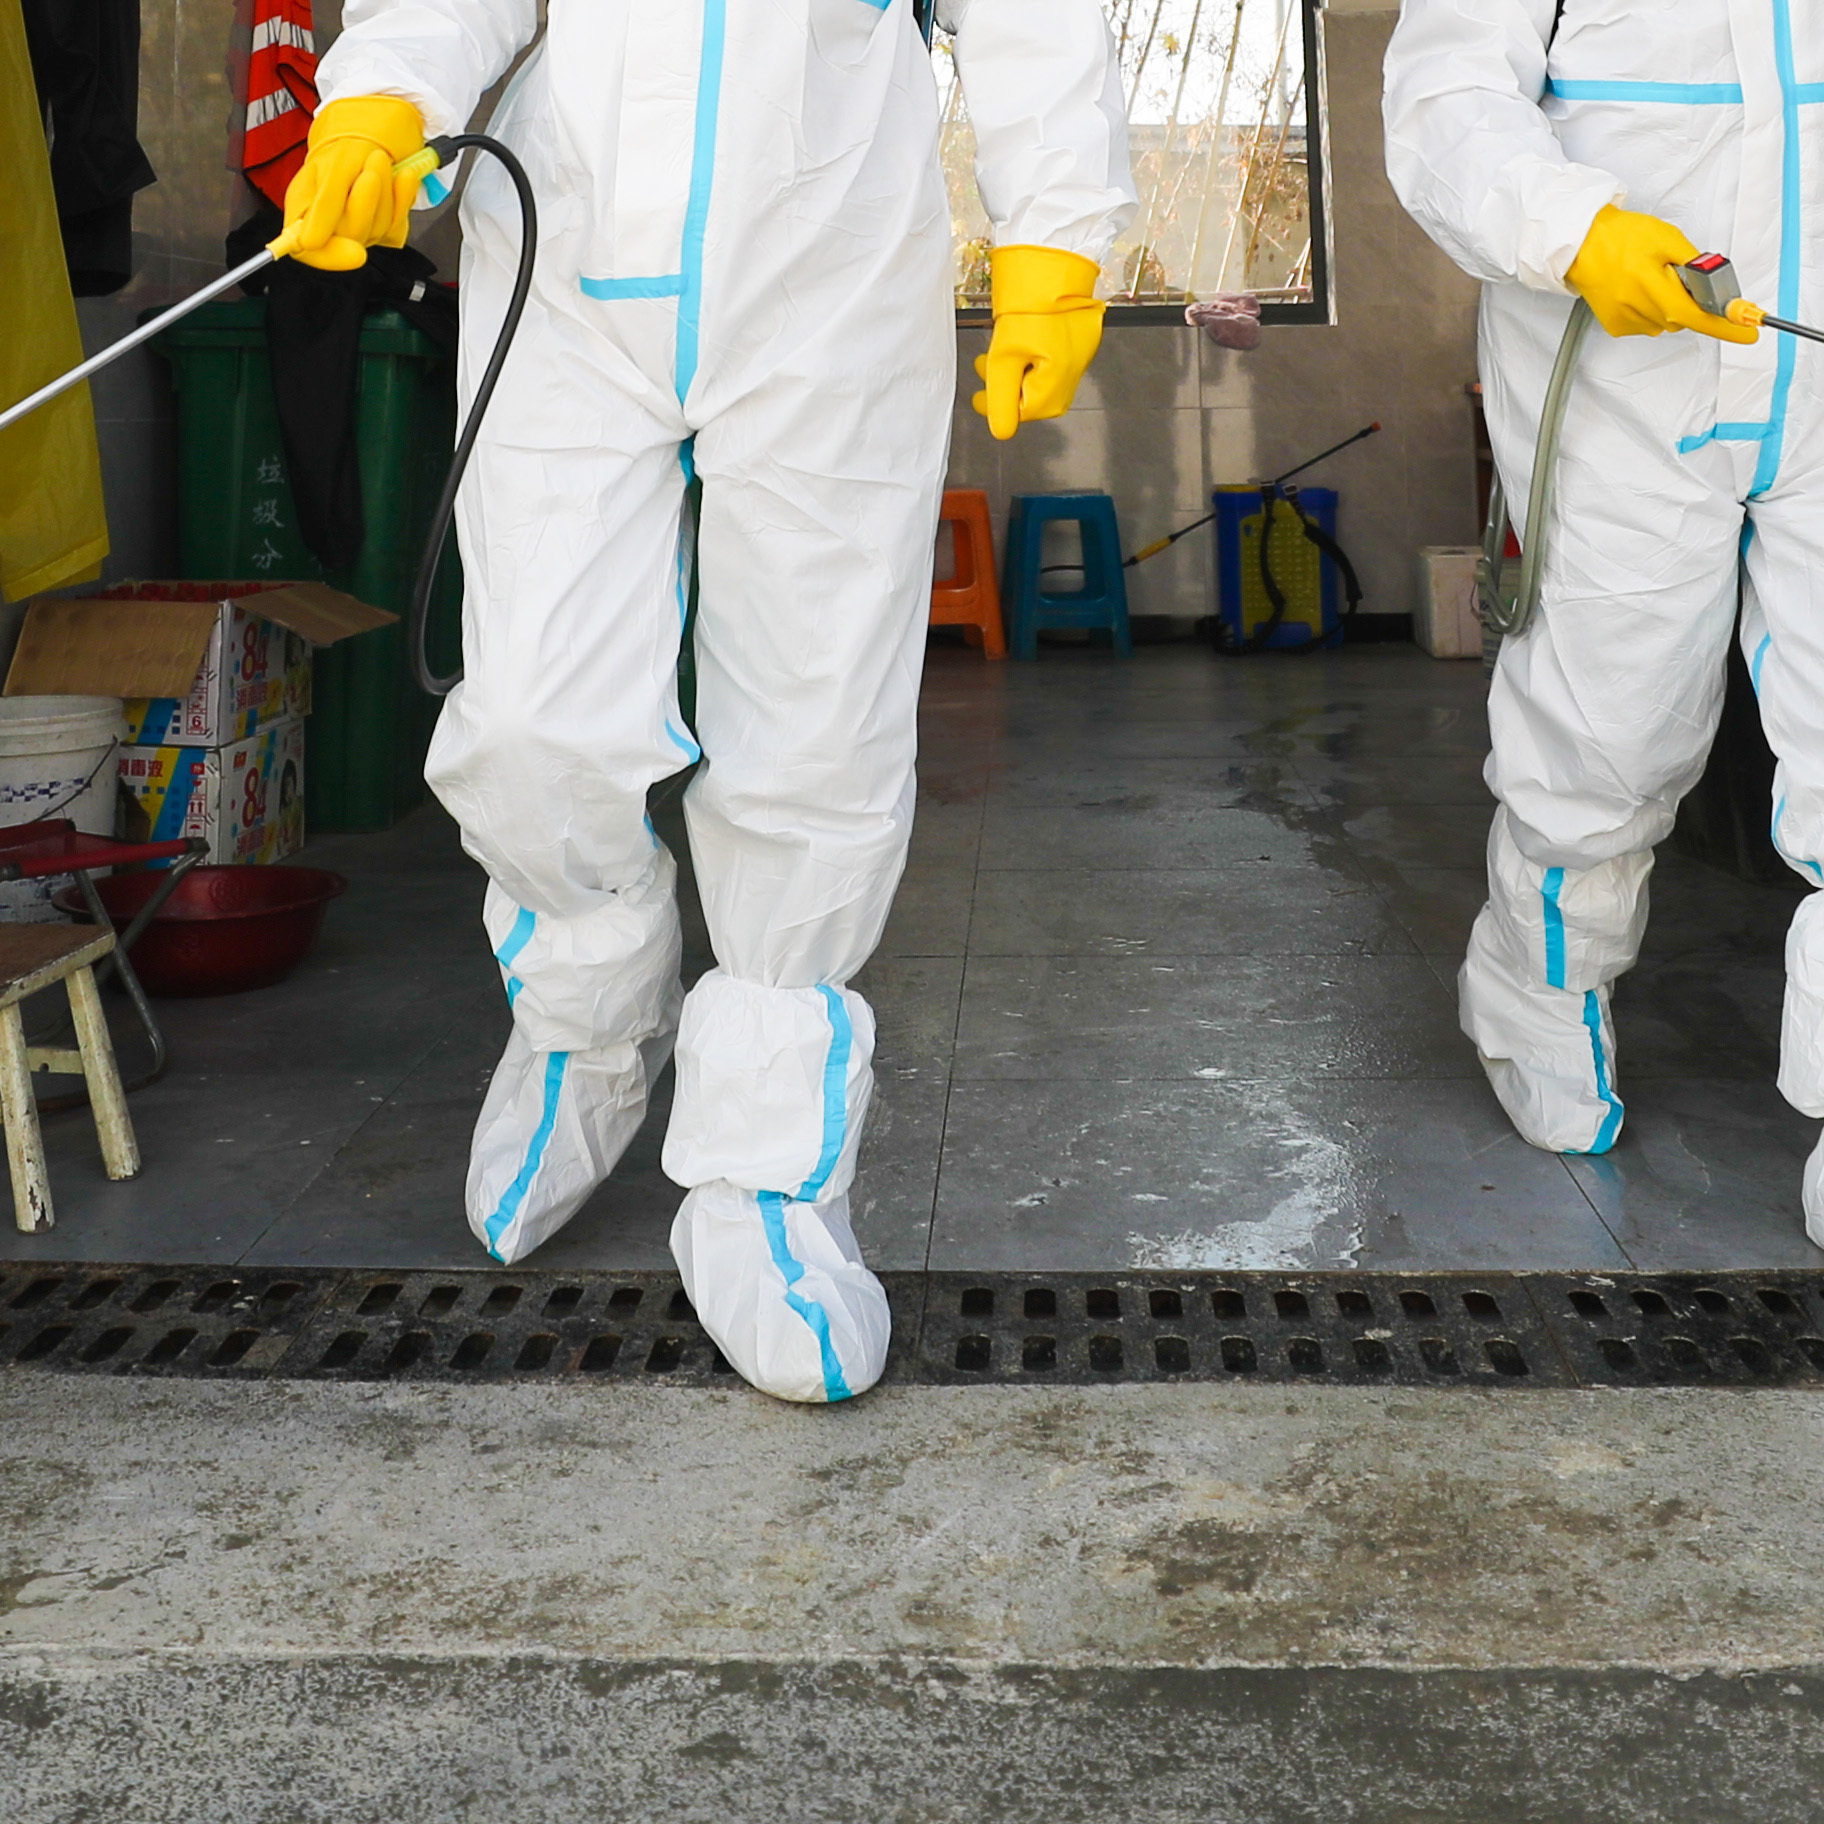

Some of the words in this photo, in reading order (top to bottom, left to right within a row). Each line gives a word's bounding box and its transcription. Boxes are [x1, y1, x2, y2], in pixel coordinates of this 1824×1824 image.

[242, 623, 270, 681] 84
[192, 714, 201, 727] 6
[242, 766, 268, 828] 84
